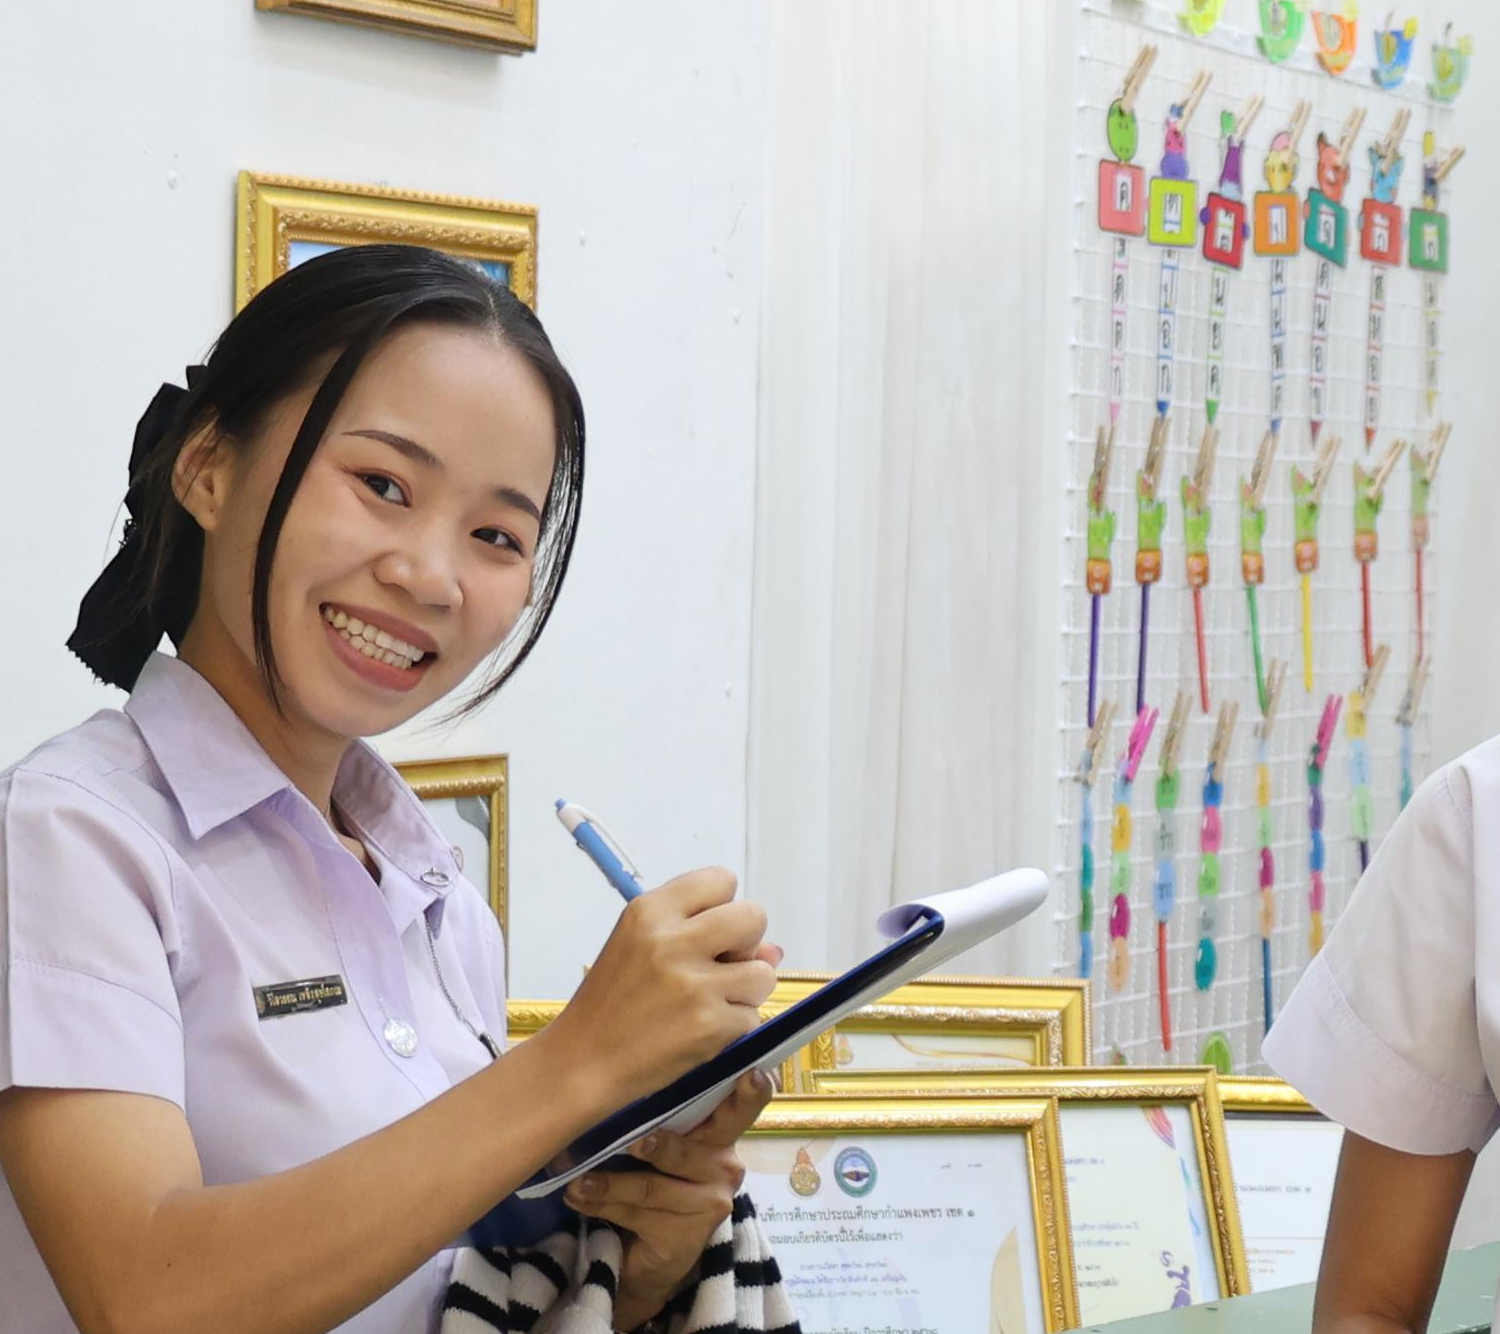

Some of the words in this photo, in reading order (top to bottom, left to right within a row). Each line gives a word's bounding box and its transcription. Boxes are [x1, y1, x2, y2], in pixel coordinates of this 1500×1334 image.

[758, 1203, 942, 1223] นที่การศึกษาประถมศึกษากำแพงเพชร
[946, 1206, 964, 1220] เขต
